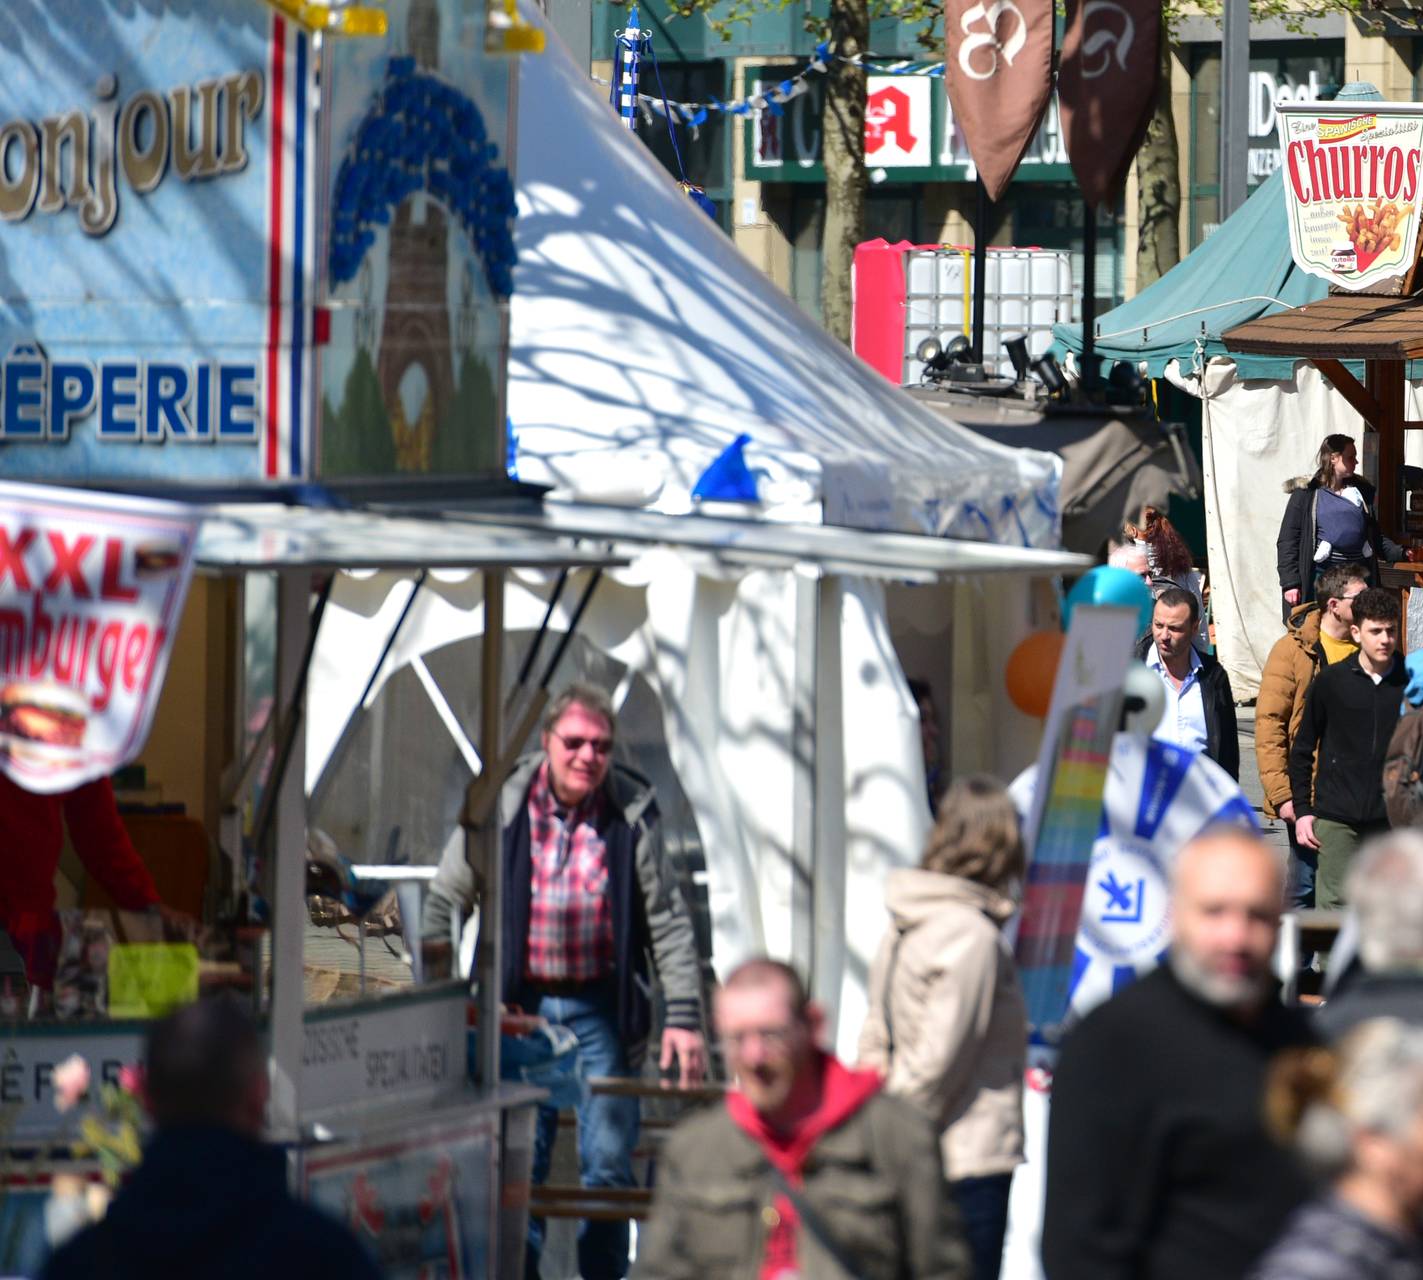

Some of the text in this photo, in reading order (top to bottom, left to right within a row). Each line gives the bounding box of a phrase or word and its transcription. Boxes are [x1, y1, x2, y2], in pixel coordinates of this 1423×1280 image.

[1318, 116, 1374, 138] SPANISCHE
[1287, 139, 1421, 204] Churros
[1, 341, 260, 441] ÊPERIE
[0, 526, 139, 604] XXL
